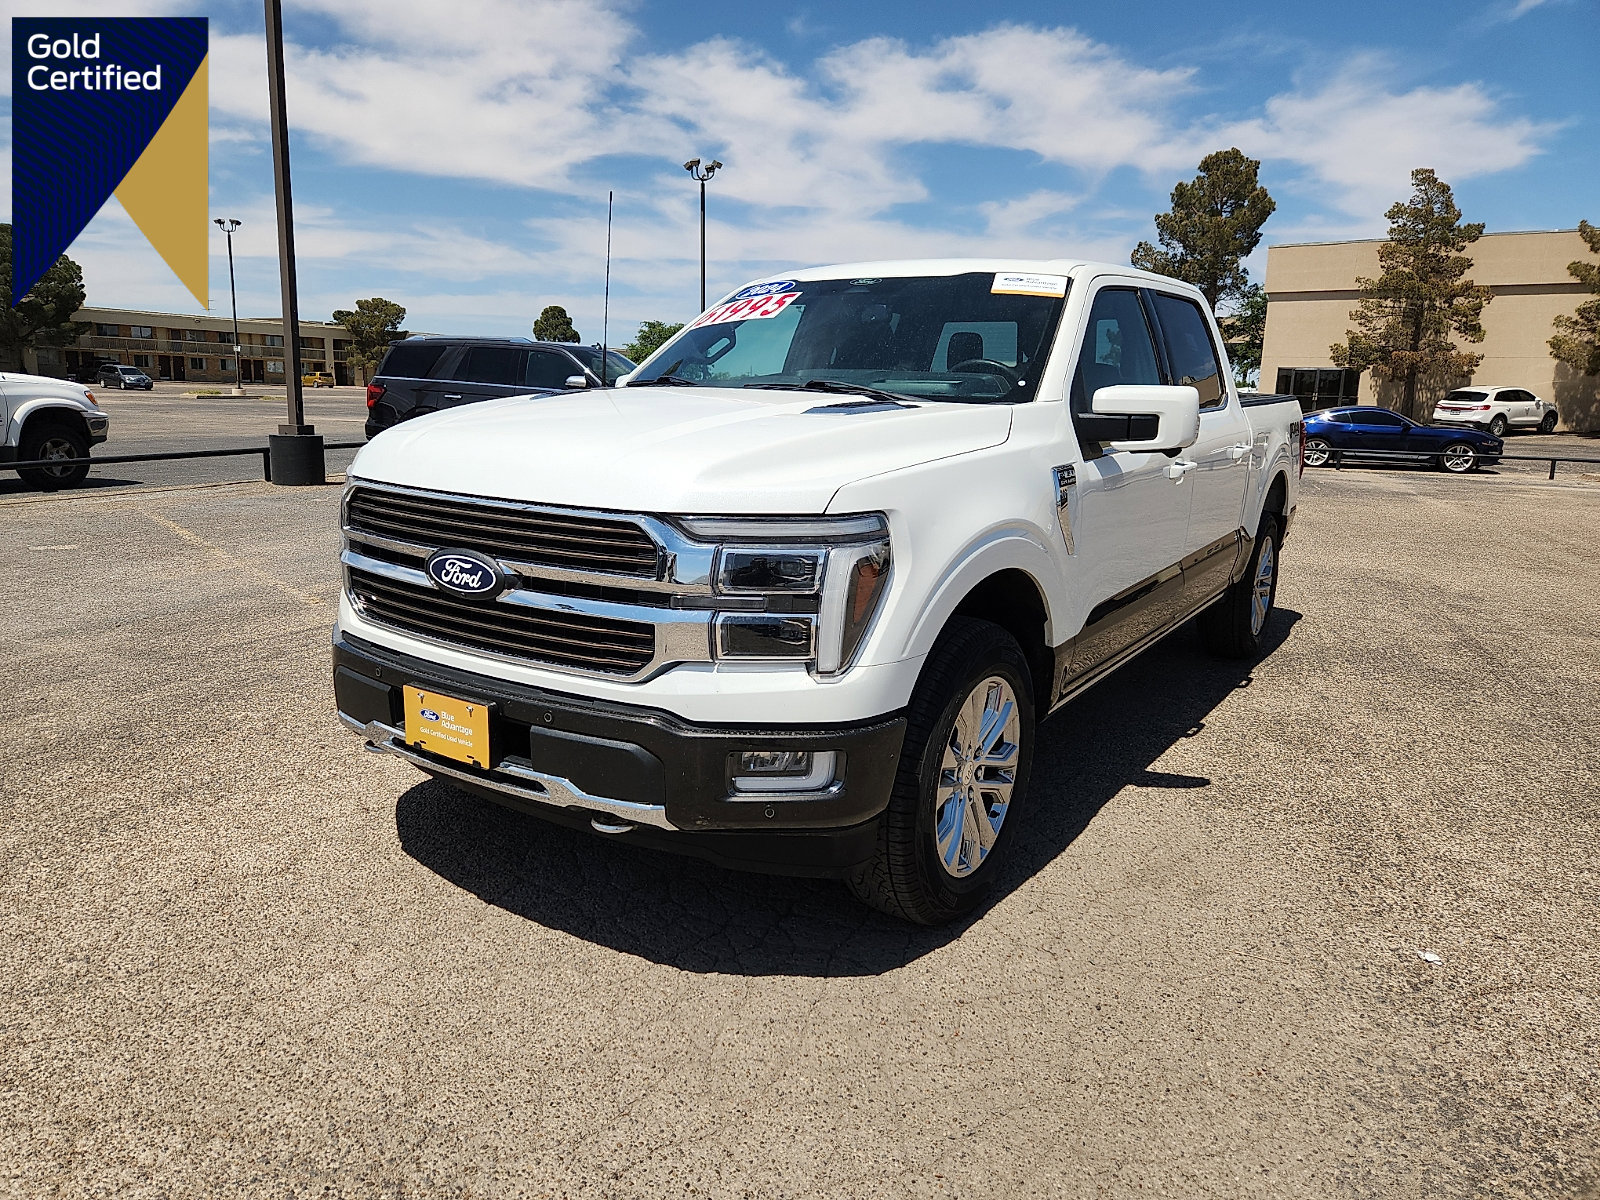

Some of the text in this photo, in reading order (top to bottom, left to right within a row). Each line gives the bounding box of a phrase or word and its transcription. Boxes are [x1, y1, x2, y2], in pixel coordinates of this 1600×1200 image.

[441, 559, 483, 588] Ford
[441, 711, 455, 722] Blue
[420, 726, 431, 735] Gold
[430, 729, 447, 740] Certified
[441, 720, 473, 736] Advantage
